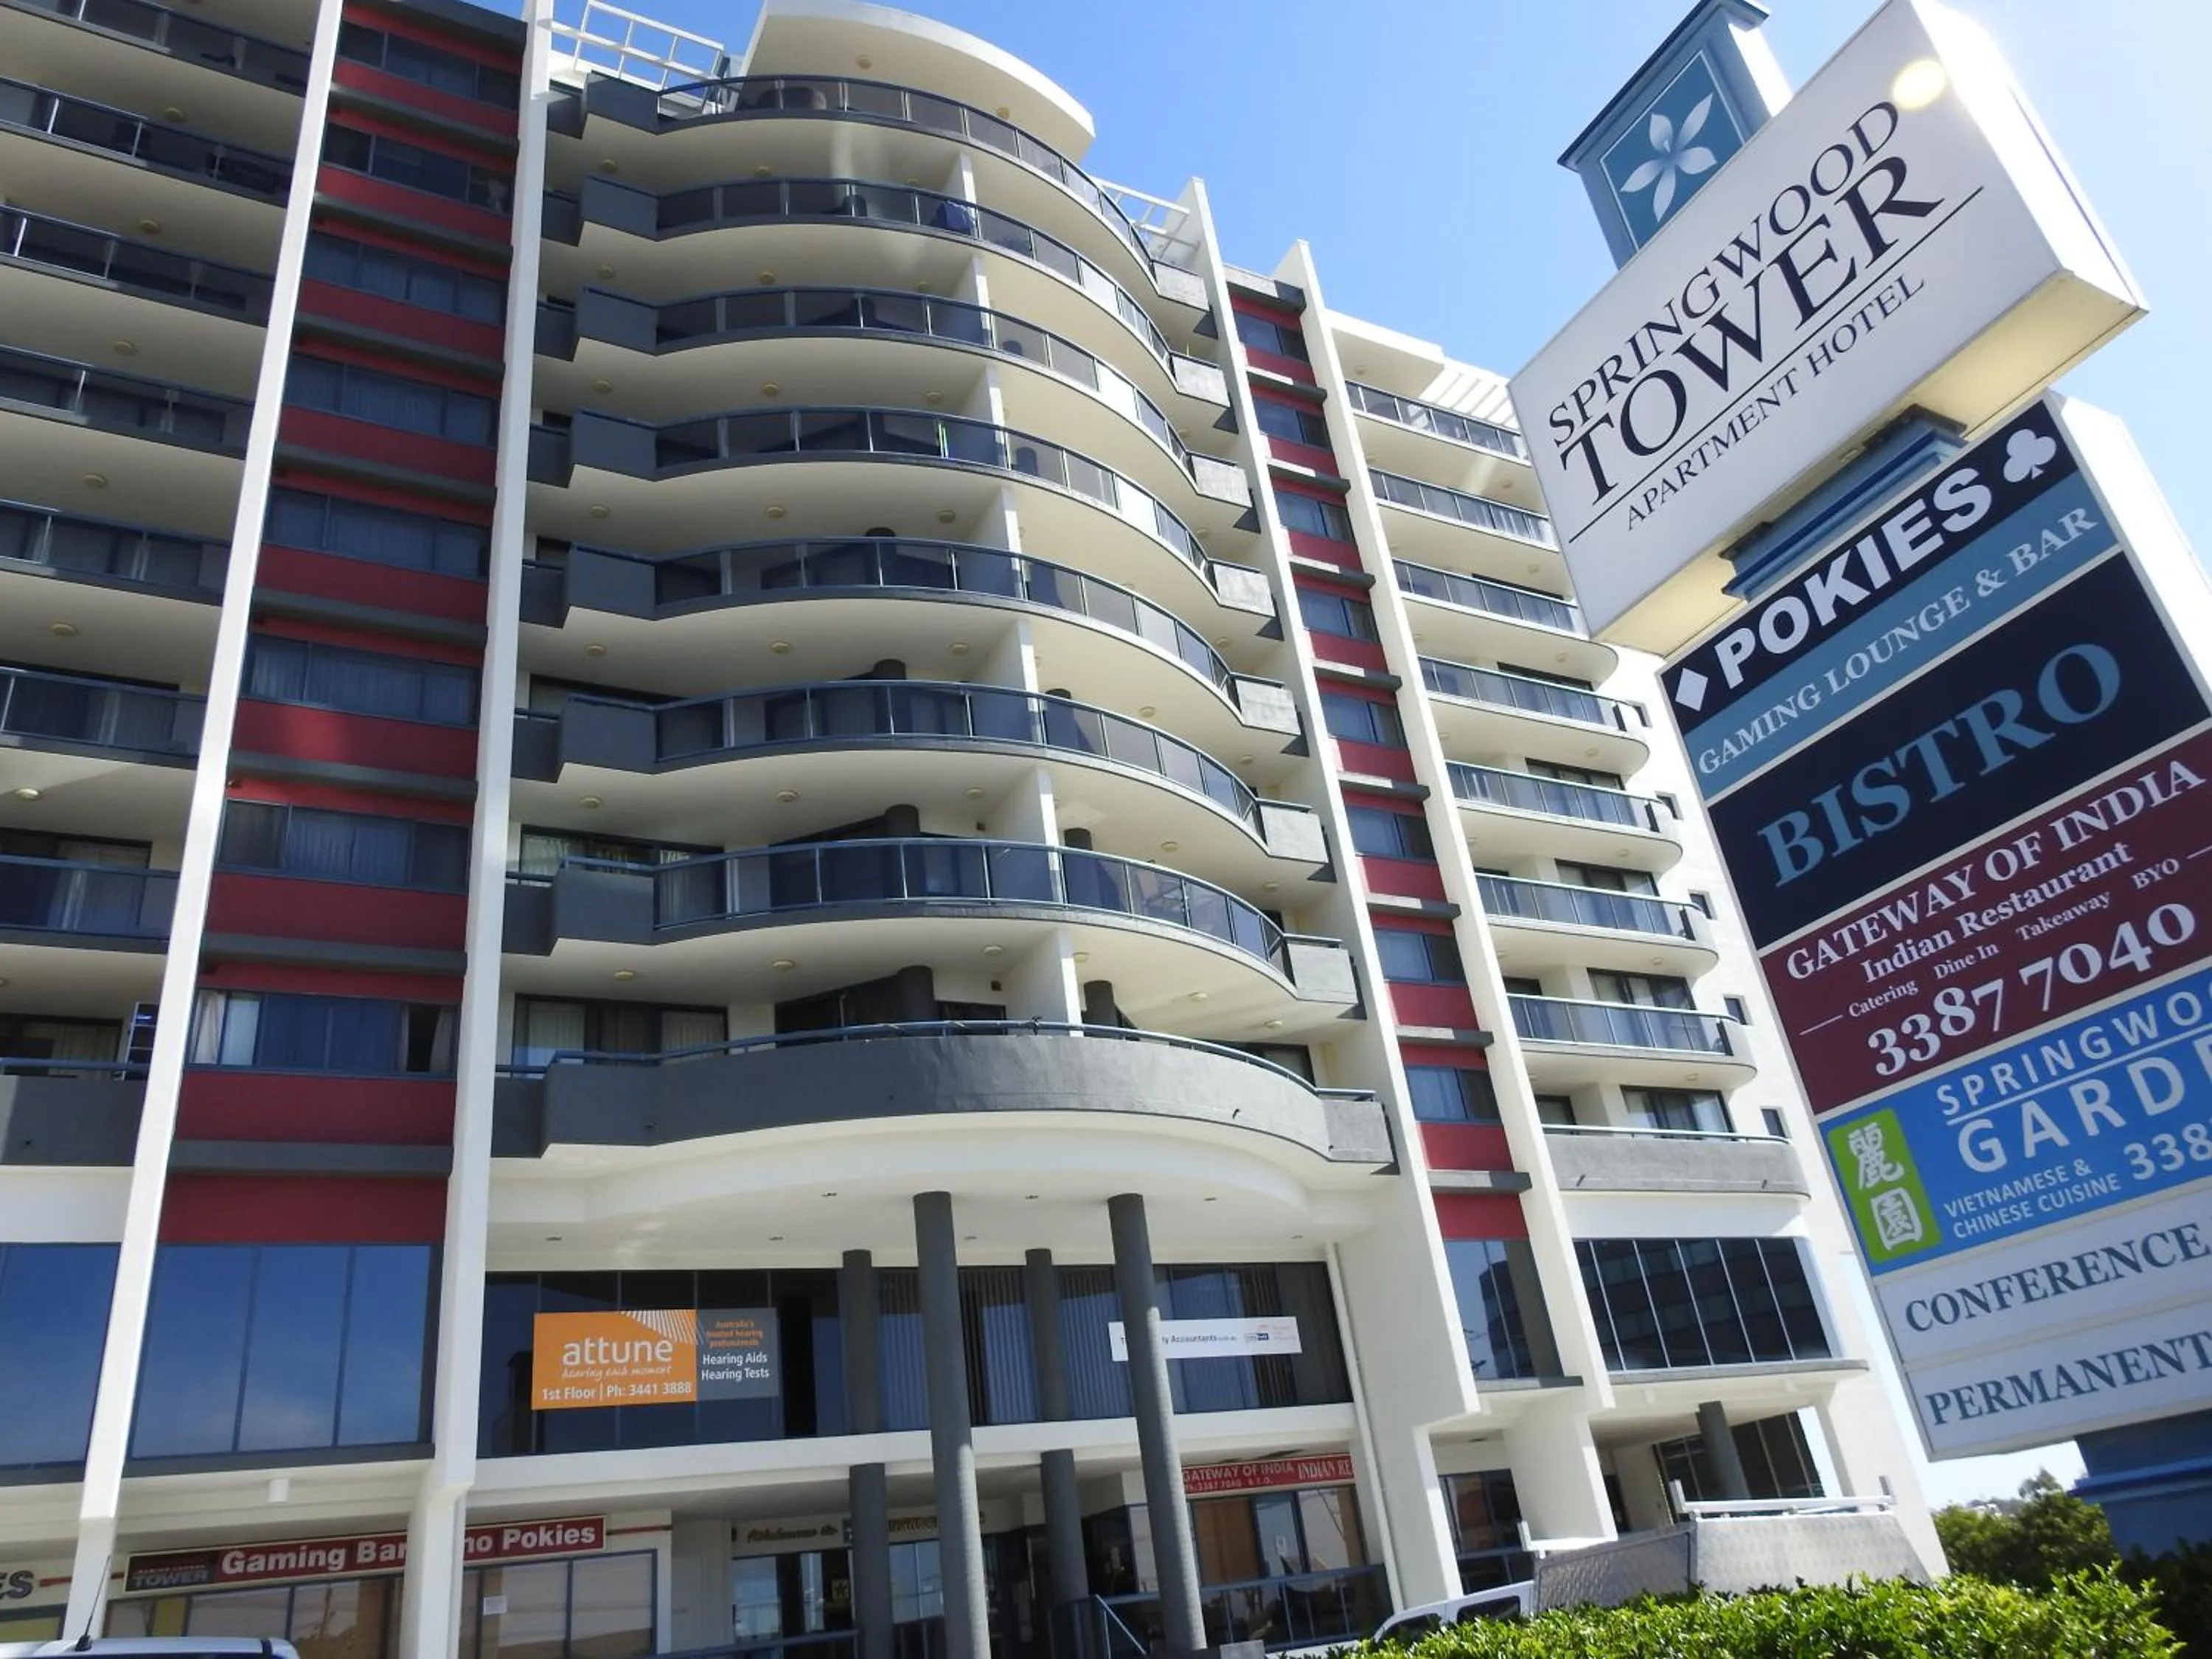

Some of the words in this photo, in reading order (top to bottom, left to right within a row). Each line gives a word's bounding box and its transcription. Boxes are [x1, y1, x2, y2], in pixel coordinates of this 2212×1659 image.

[1548, 101, 1899, 447] SPRINGWOOD
[1560, 156, 1946, 505] TOWER
[1627, 368, 1798, 530] APARTMENT
[1806, 271, 1925, 378] HOTEL
[1714, 467, 1992, 690] POKIES
[1697, 684, 1822, 776] GAMING
[1823, 587, 1972, 698] LOUNGE
[1975, 569, 2006, 599] &
[2006, 507, 2098, 579] BAR
[1758, 643, 2121, 887] BISTRO
[1787, 864, 1977, 981] GATEWAY
[1984, 832, 2043, 882] OF
[2048, 760, 2206, 852] INDIA
[1861, 927, 1955, 983] Indian
[1955, 841, 2135, 939] Restaurant
[1848, 979, 1919, 1018] Catering
[1933, 952, 1977, 981] Dine
[1977, 942, 2000, 963] In
[2016, 890, 2112, 942] Takeaway
[2132, 858, 2181, 891] BYO
[1867, 978, 2005, 1077] 3387
[2018, 902, 2197, 1013] 7040
[1936, 979, 2212, 1116] SPRINGWO
[1944, 1165, 2067, 1218] VIETNAMESE
[2073, 1158, 2093, 1177] &
[1952, 1200, 2034, 1239] CHINESE
[2038, 1174, 2122, 1212] CUISINE
[1906, 1222, 2211, 1332] CONFERENCE
[542, 1388, 560, 1399] 1st
[565, 1386, 595, 1399] Floor
[628, 1382, 658, 1396] 3441
[663, 1381, 692, 1394] 3888
[562, 1337, 672, 1366] attune
[701, 1368, 742, 1382] Hearing
[744, 1367, 770, 1379] Tests
[703, 1353, 742, 1366] Hearing
[745, 1352, 768, 1363] Aids
[1924, 1331, 2212, 1425] PERMANENT
[1243, 1464, 1258, 1477] OF
[1261, 1461, 1295, 1475] INDIA
[1298, 1459, 1335, 1480] INDIAN
[132, 1570, 209, 1587] TOWER
[222, 1545, 346, 1576] Gaming
[503, 1523, 595, 1549] Pokies
